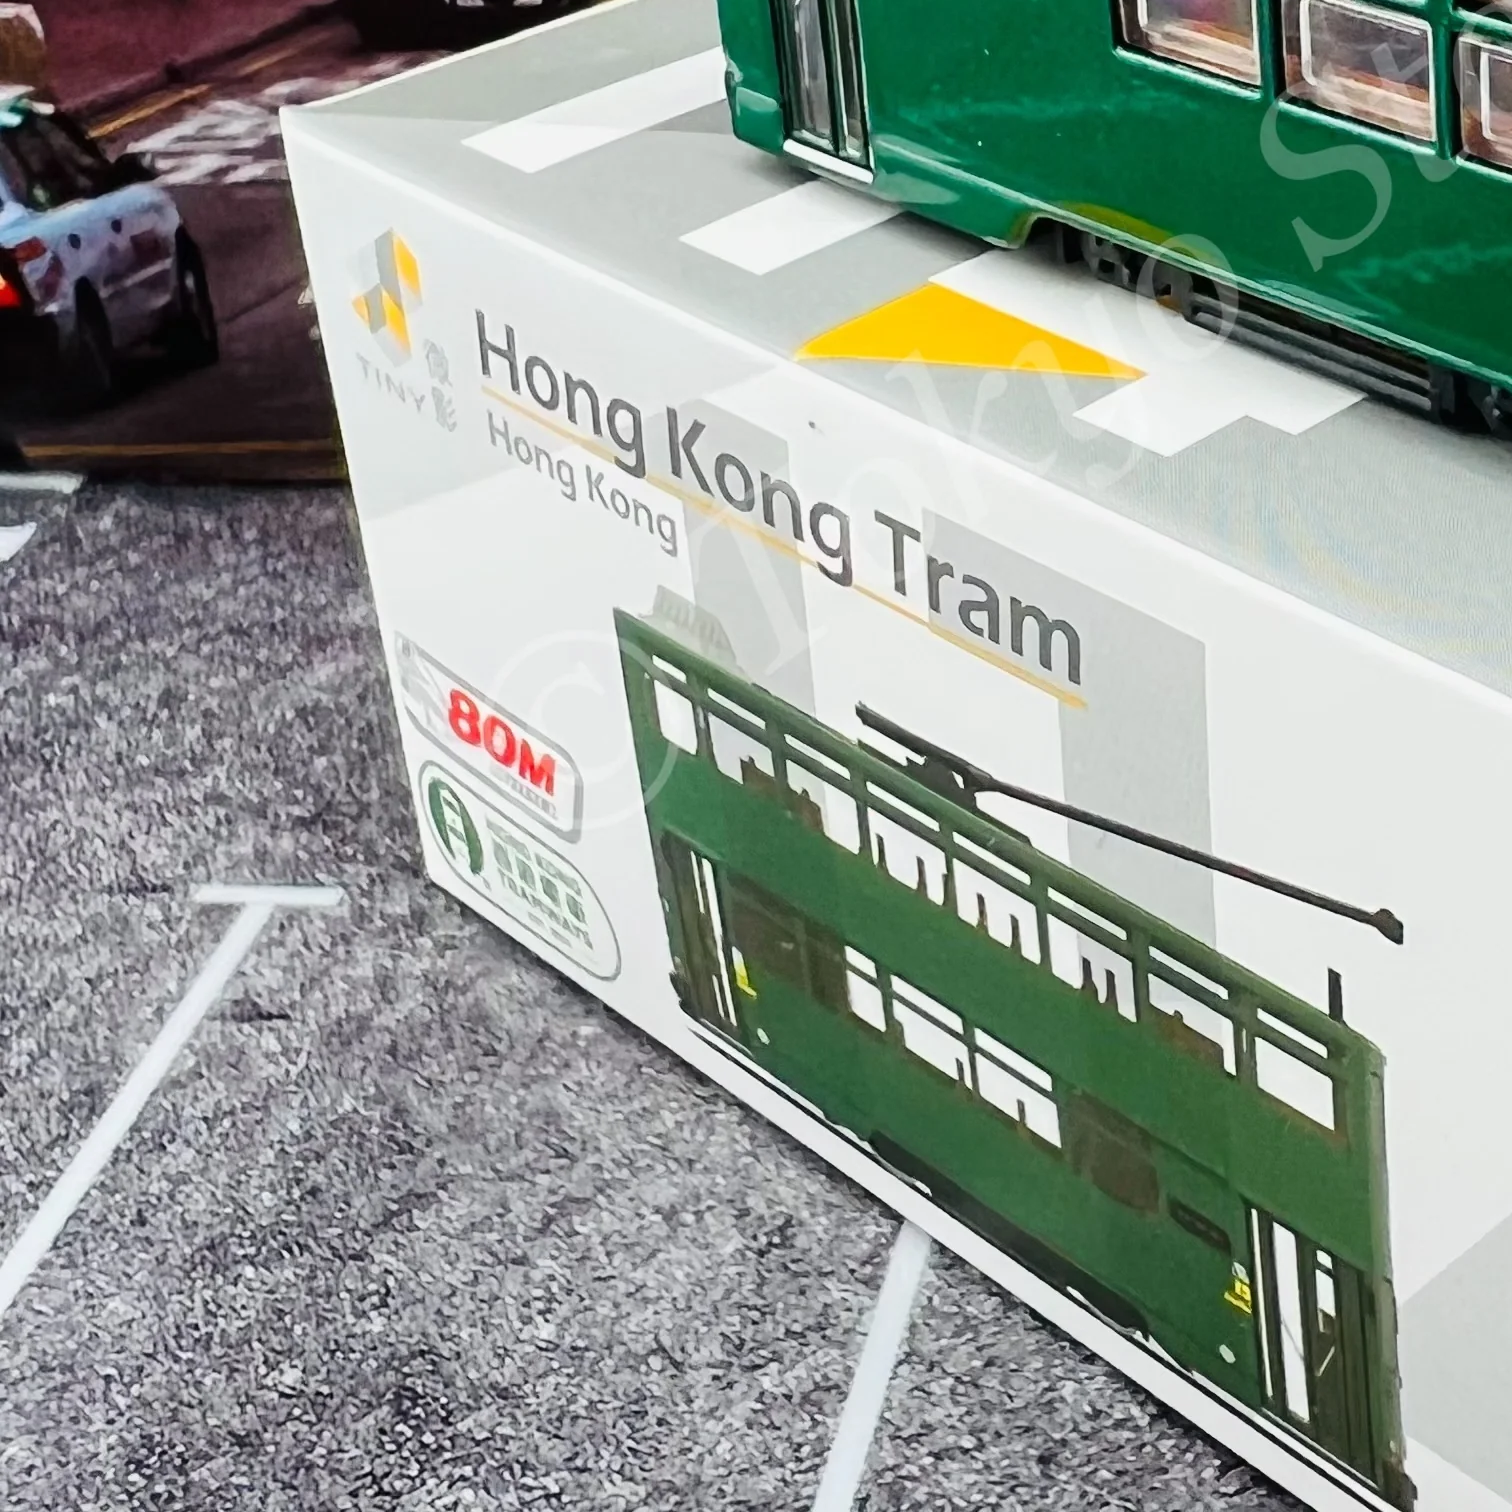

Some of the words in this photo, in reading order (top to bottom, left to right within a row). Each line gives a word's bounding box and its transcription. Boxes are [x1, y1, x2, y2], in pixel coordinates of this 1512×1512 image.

[355, 351, 426, 413] TINY
[475, 308, 647, 479] Hong
[666, 405, 853, 588] Kong
[873, 508, 1082, 686] Tram
[487, 409, 577, 503] Hong
[585, 463, 678, 558] Kong
